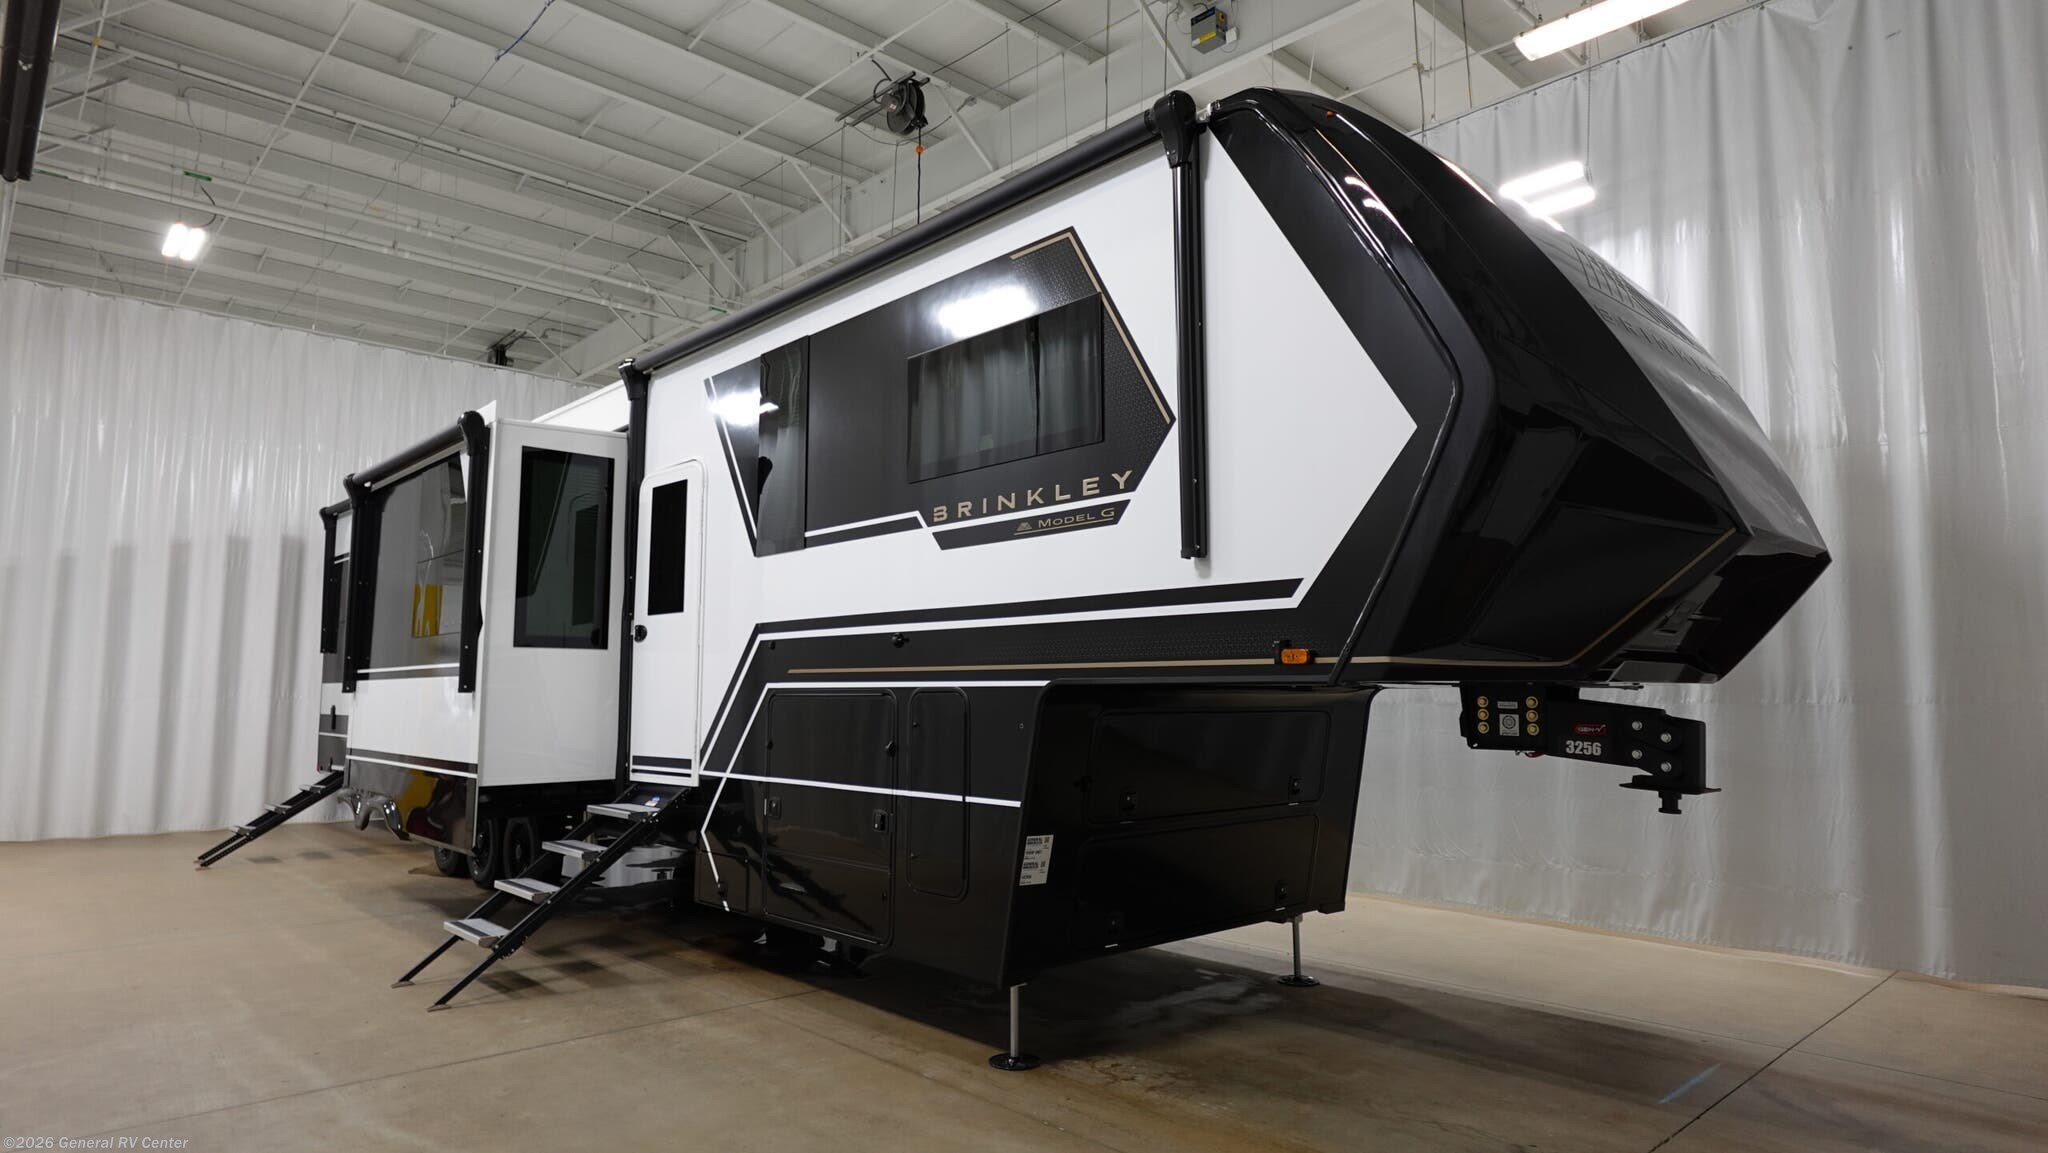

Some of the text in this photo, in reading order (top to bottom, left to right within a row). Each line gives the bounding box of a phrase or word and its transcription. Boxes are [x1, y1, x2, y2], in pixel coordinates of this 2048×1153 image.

[932, 470, 1133, 522] BRINKLEY
[1101, 507, 1115, 518] G
[1566, 740, 1602, 756] 3256
